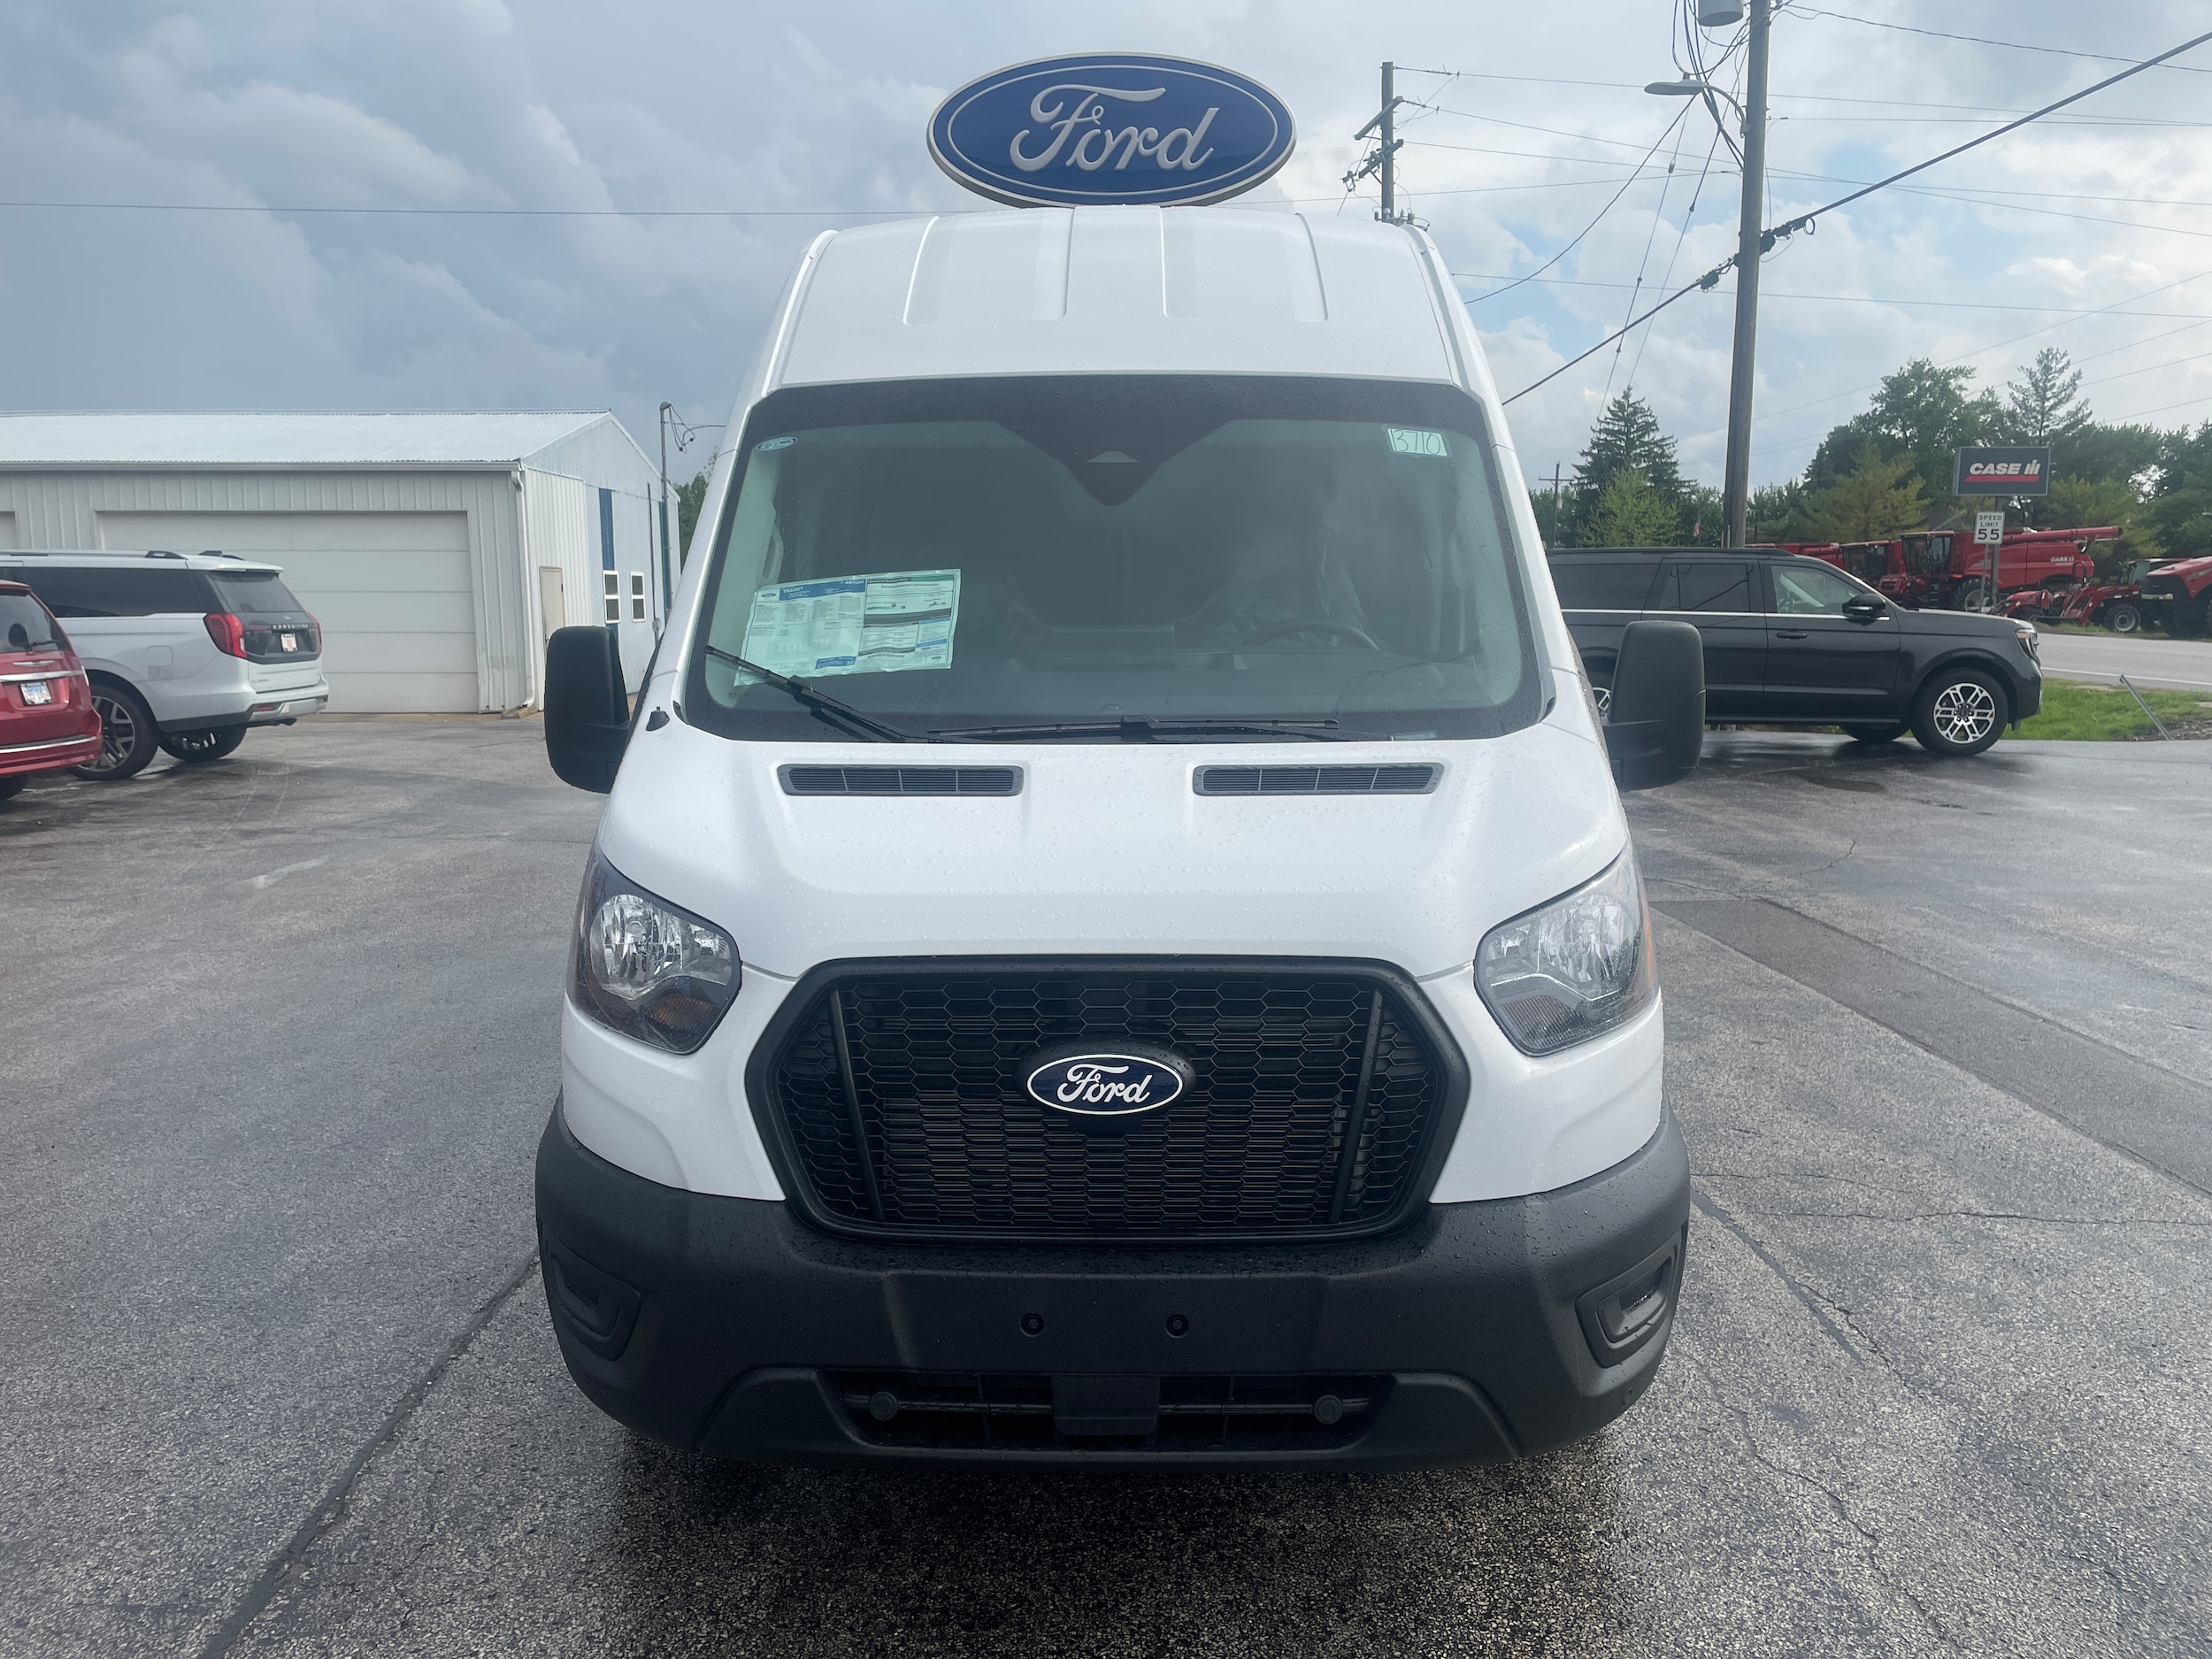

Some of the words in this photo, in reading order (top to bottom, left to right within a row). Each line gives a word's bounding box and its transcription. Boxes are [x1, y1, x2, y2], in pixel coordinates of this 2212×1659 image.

[1010, 84, 1219, 172] Ford
[1970, 463, 2022, 475] CASE
[1978, 528, 2000, 541] 55
[1056, 1064, 1153, 1103] Ford
